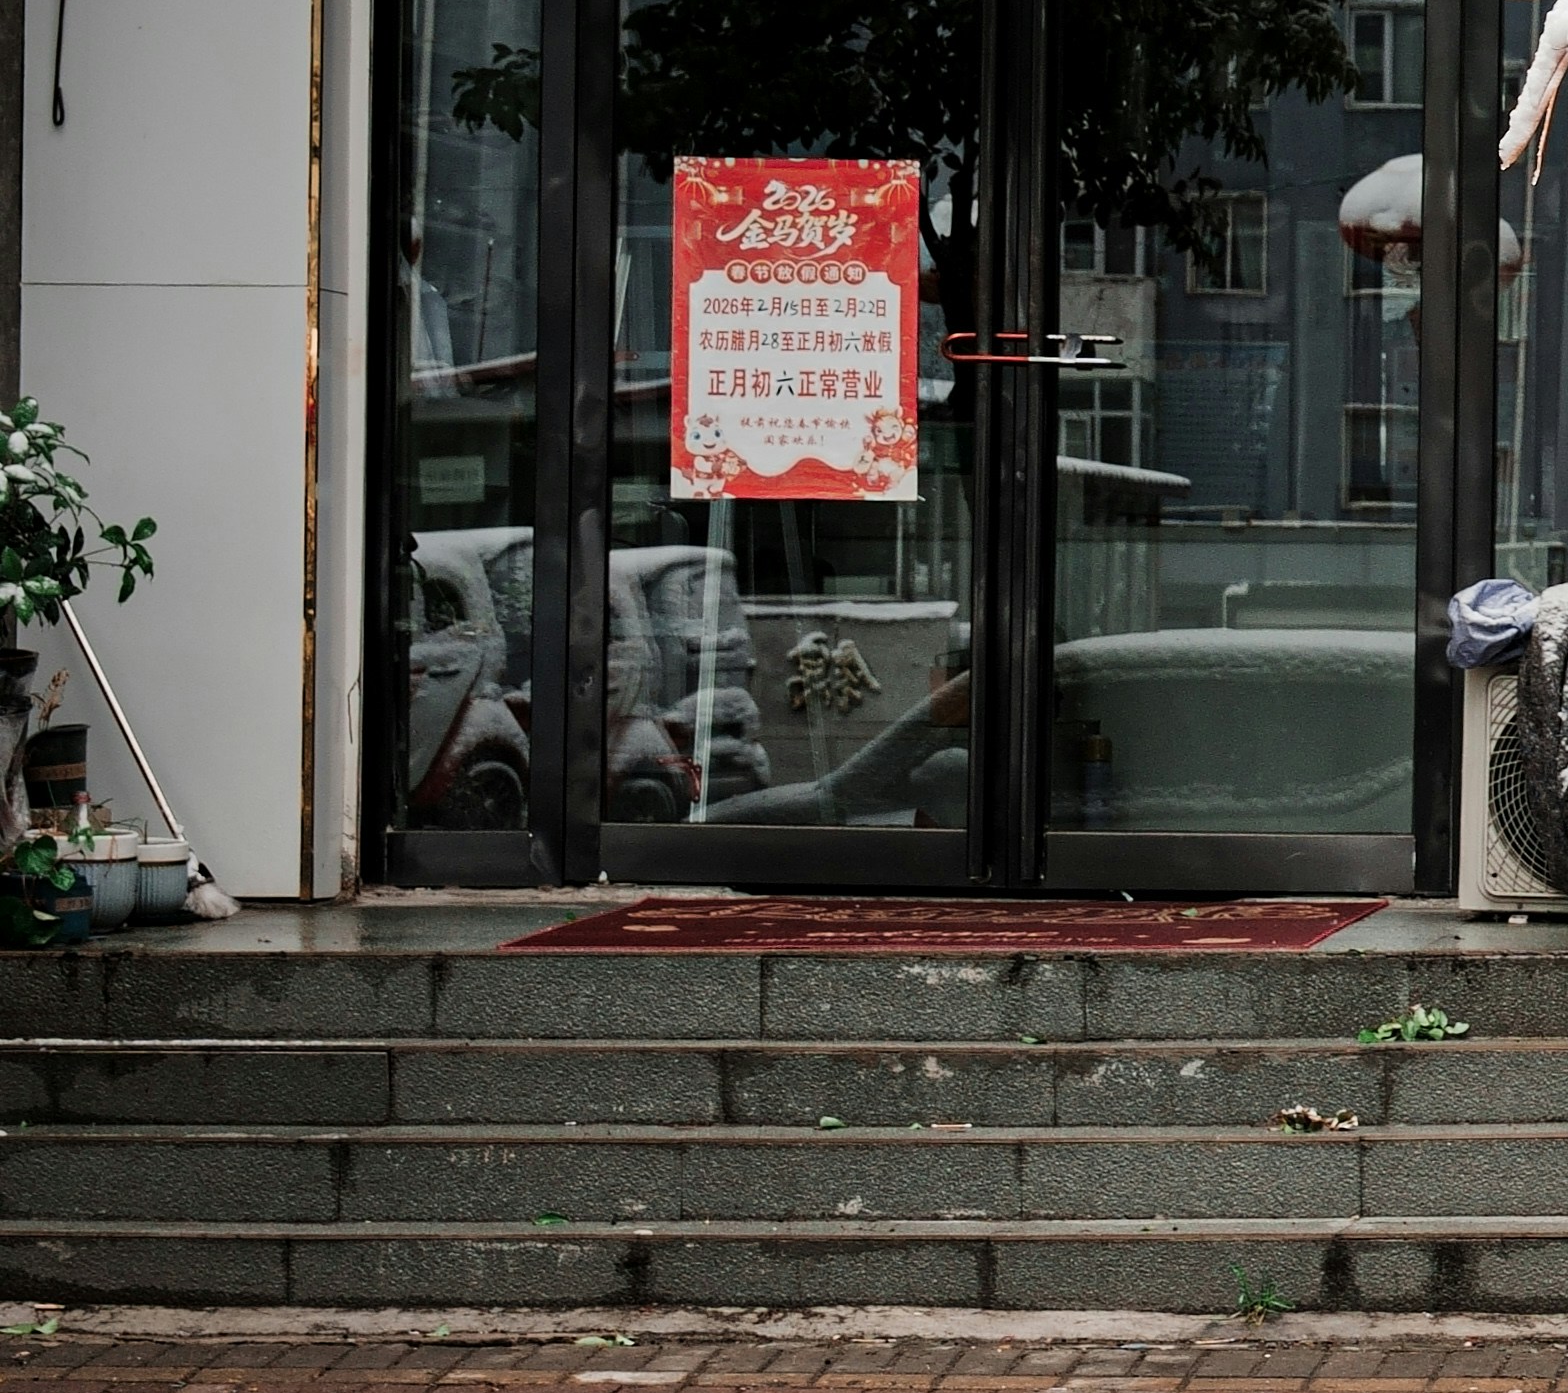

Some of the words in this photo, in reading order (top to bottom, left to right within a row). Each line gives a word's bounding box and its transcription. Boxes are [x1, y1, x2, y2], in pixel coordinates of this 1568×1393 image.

[763, 180, 836, 212] 2026
[716, 209, 859, 261] 金马贺岁
[729, 264, 863, 283] 春节放假通知
[708, 368, 884, 400] 正月初六正常营业
